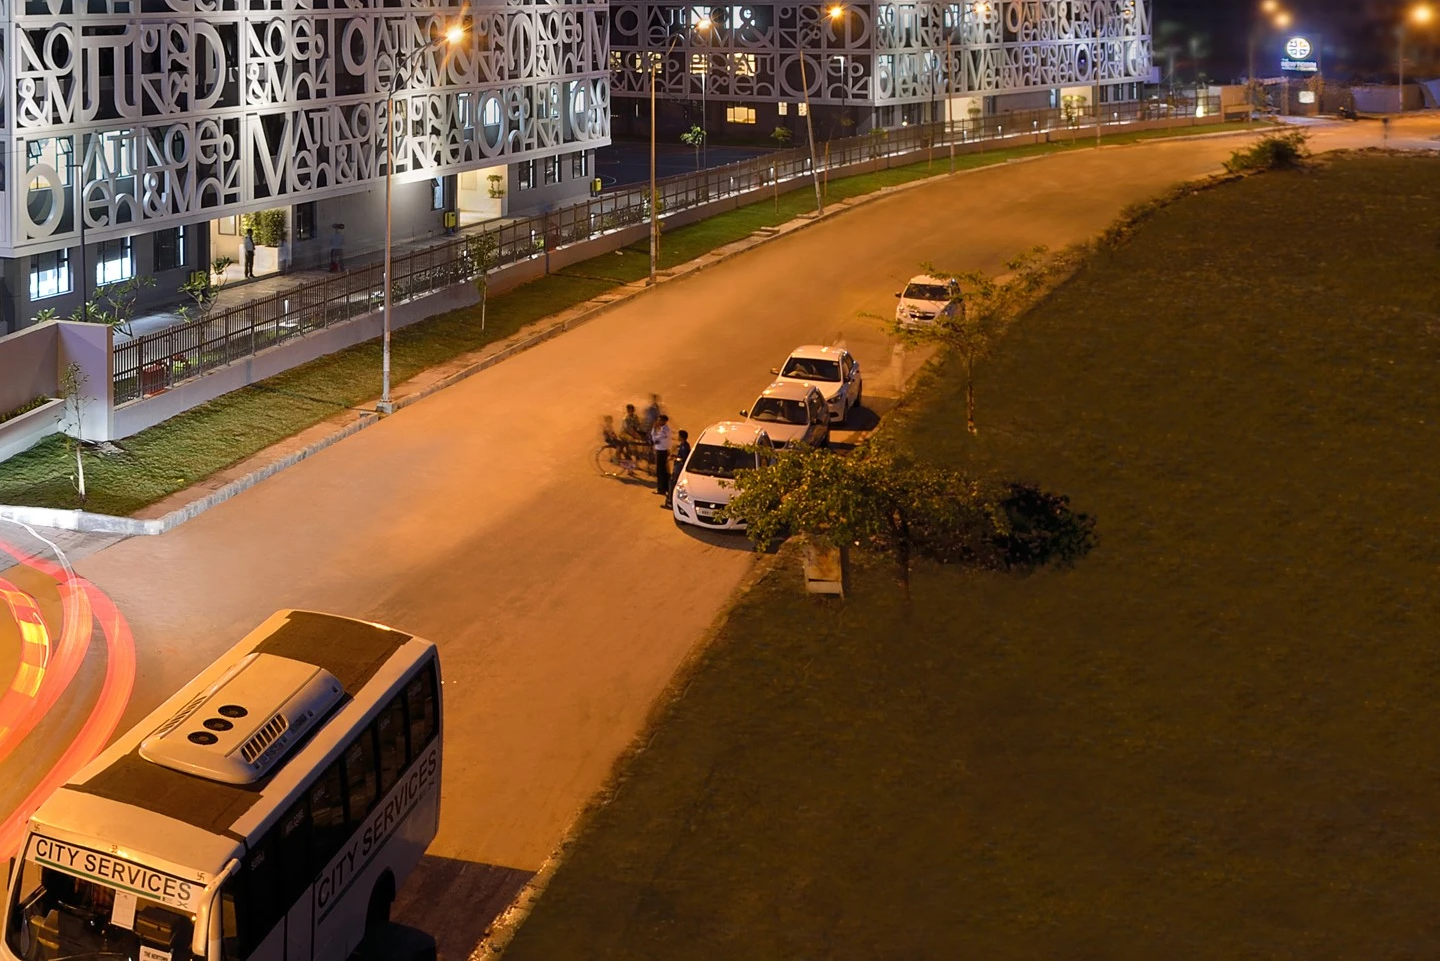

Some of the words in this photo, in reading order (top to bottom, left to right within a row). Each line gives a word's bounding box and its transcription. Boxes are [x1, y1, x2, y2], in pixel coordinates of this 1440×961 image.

[36, 839, 80, 867] CITY
[84, 854, 191, 901] SERVICES
[318, 842, 358, 909] CITY
[362, 749, 437, 856] SERVICES
